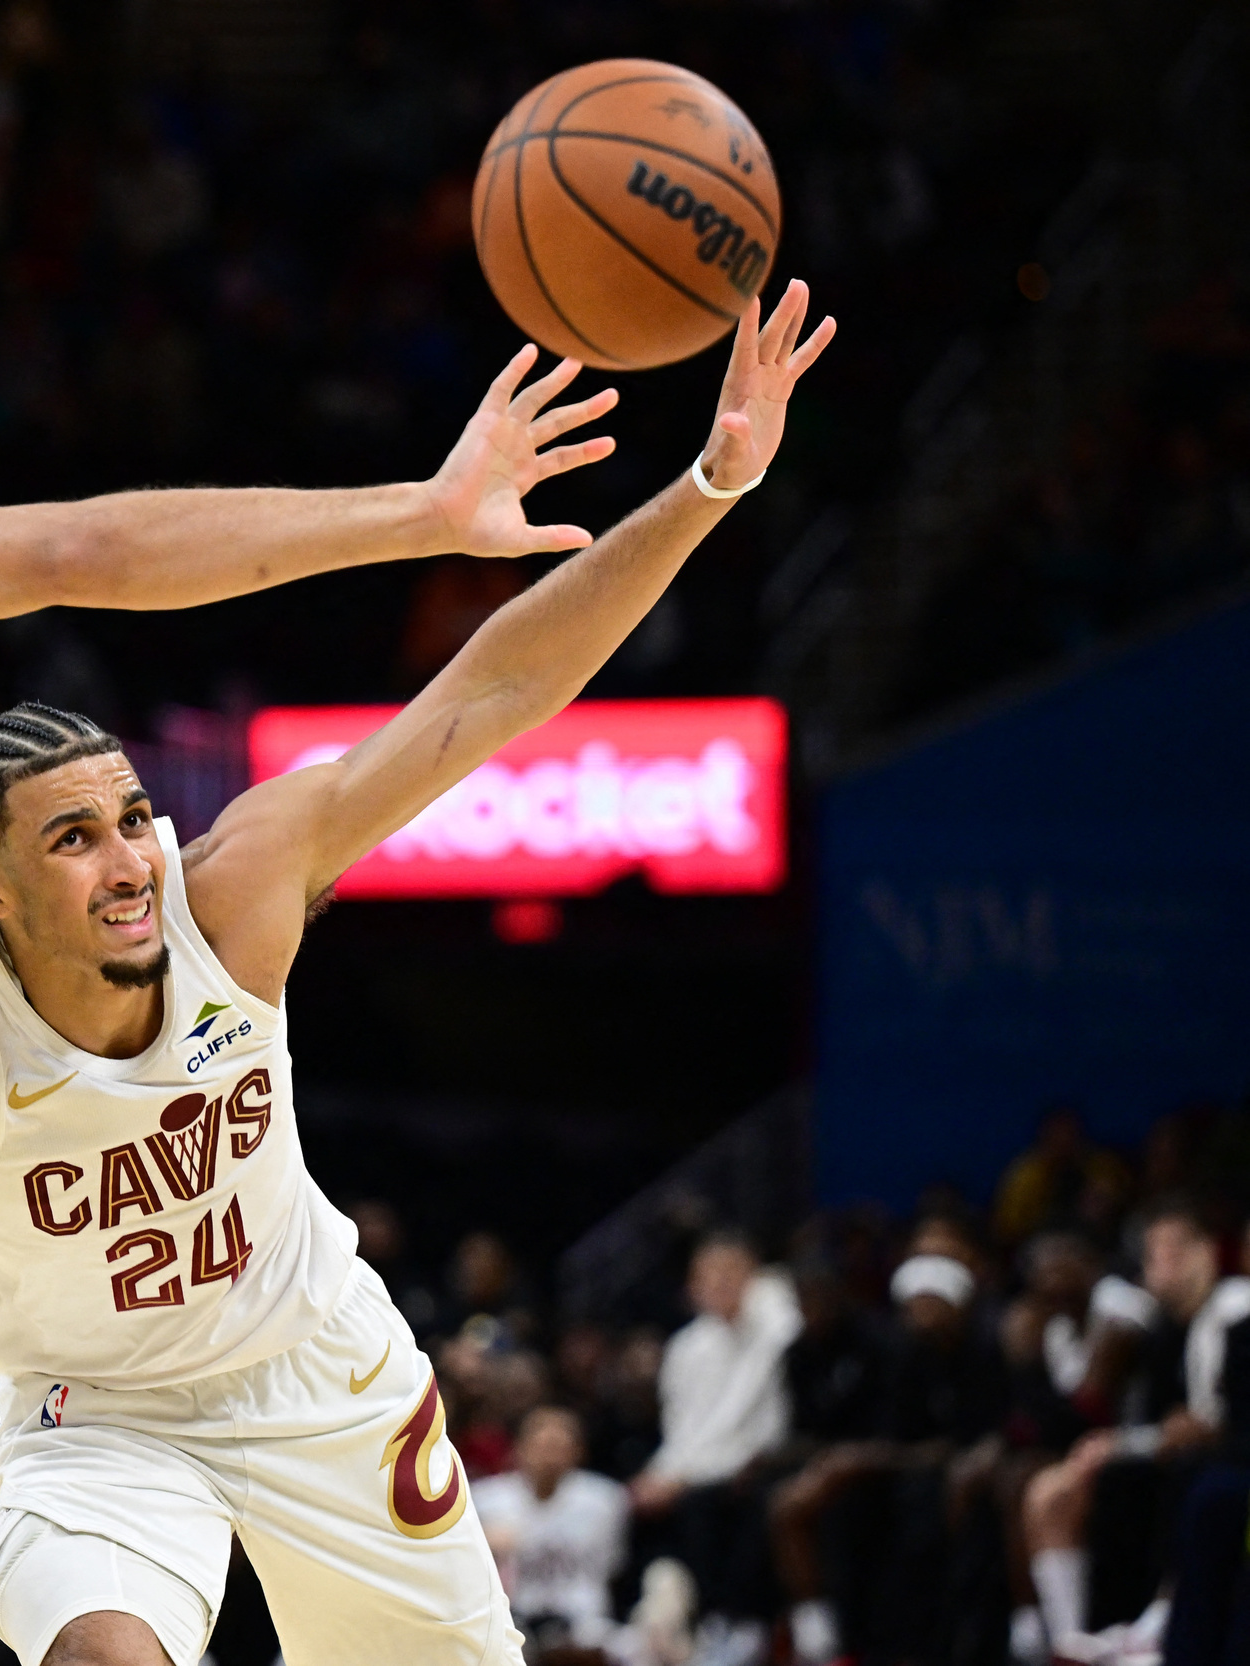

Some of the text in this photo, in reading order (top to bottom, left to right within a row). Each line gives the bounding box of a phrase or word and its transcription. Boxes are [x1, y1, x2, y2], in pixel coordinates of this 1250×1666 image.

[378, 738, 760, 862] ocket
[186, 1020, 252, 1074] CLIFFS
[23, 1068, 272, 1236] CAVS
[105, 1193, 253, 1312] 24
